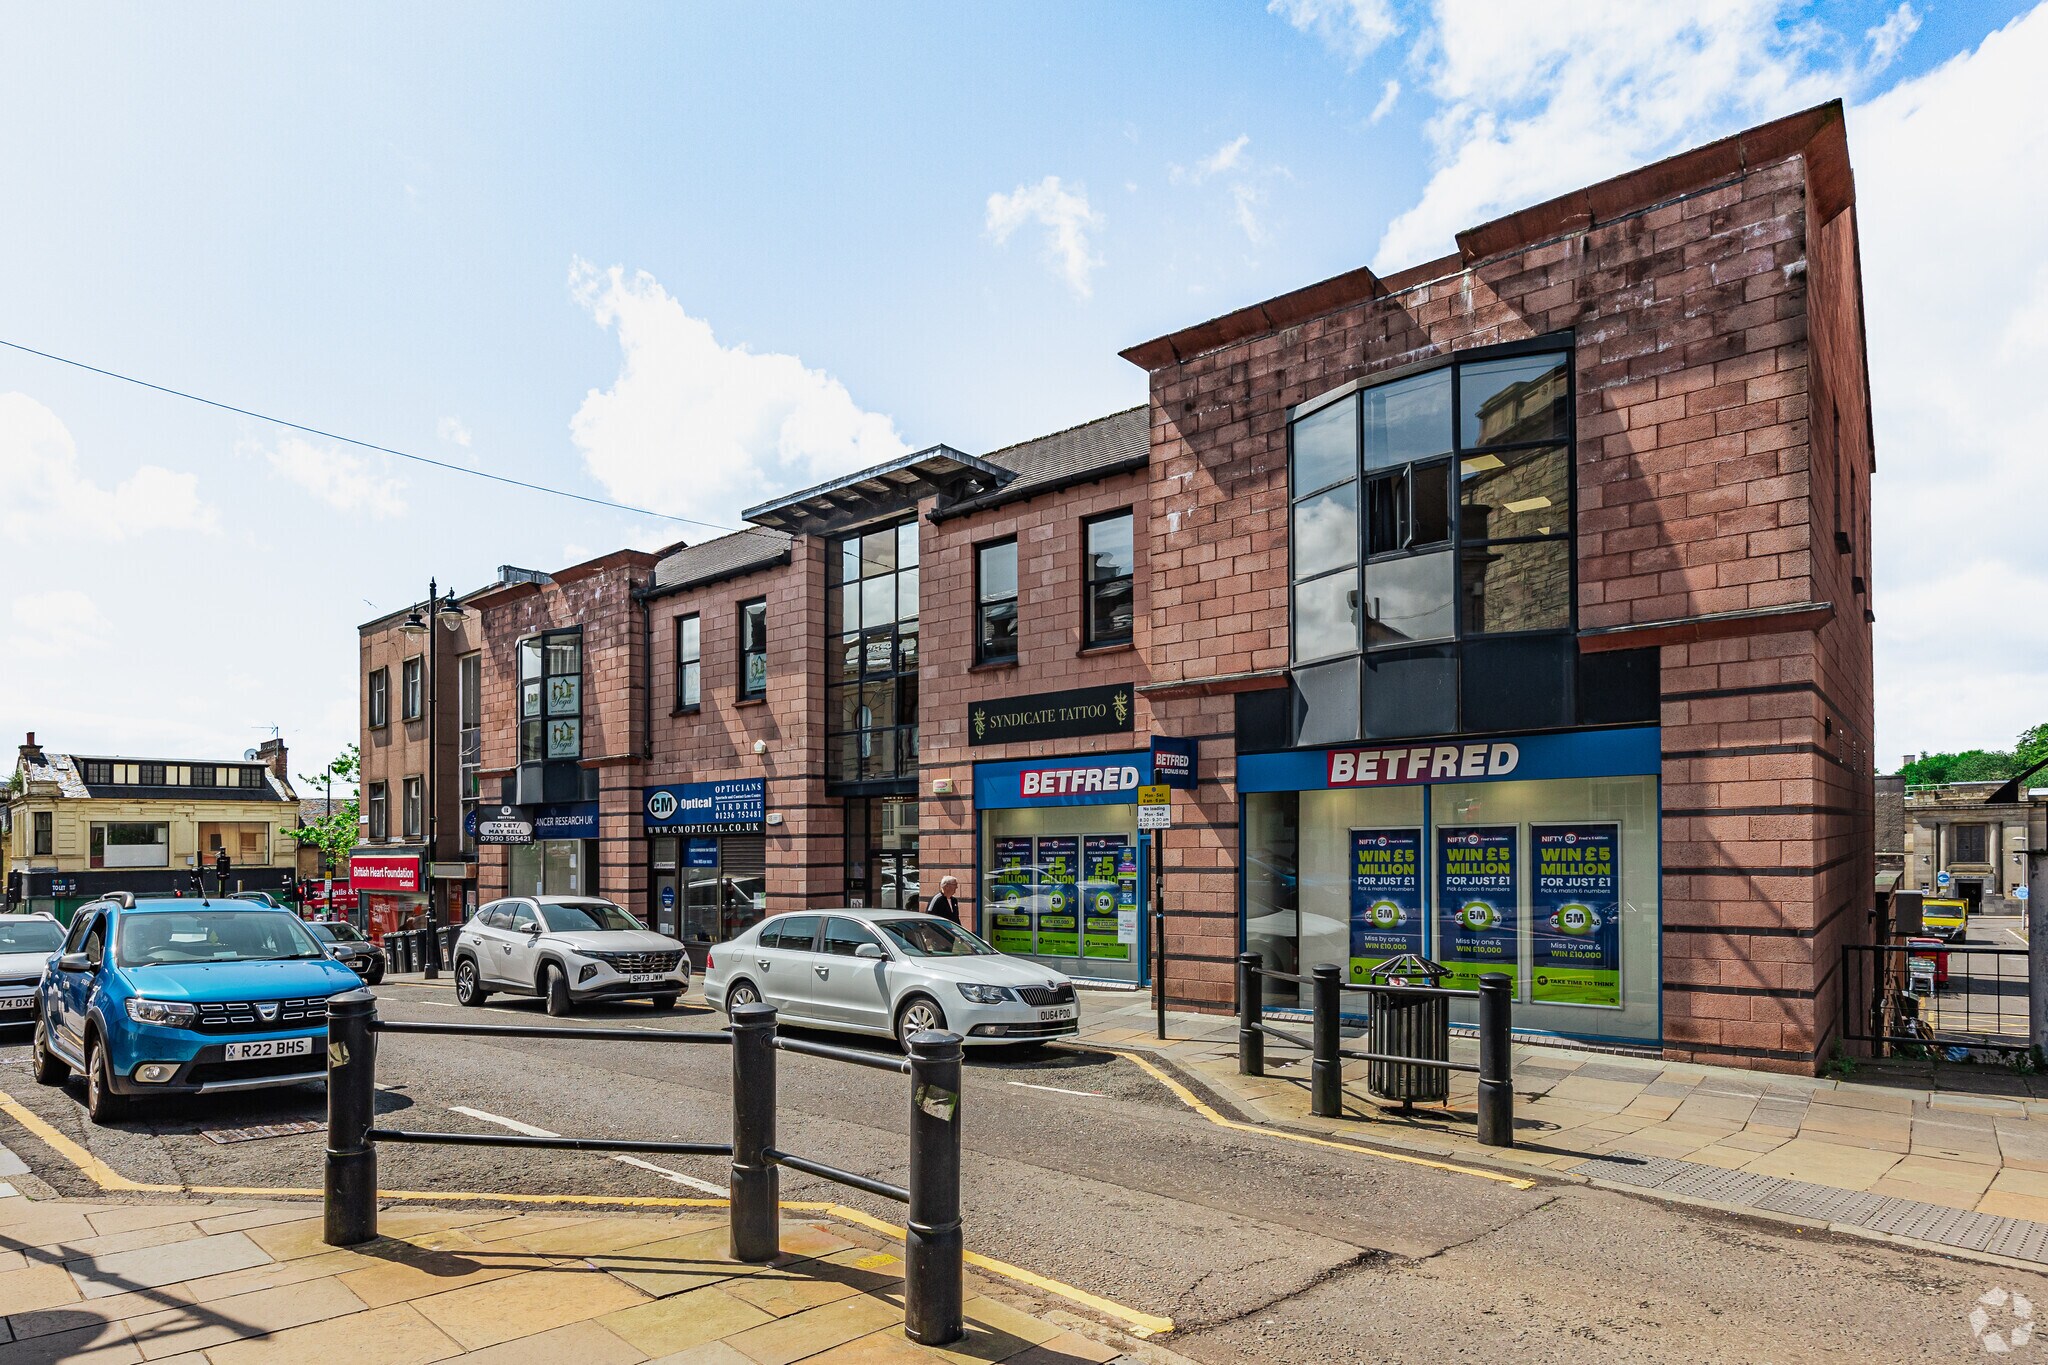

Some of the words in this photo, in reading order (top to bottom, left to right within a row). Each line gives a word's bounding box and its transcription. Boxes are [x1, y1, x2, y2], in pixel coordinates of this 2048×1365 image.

[990, 709, 1056, 729] SYNDICATE
[1058, 703, 1107, 721] TATTOO
[1156, 753, 1189, 767] BETFRED
[1331, 743, 1520, 783] BETFRED
[1023, 766, 1139, 795] BETFRED
[714, 782, 762, 794] OPTICIANS
[651, 797, 673, 813] CM
[680, 797, 712, 811] Optical
[715, 801, 762, 811] AIRDRIE
[715, 811, 735, 819] 01236
[737, 810, 761, 819] 752481
[534, 817, 554, 826] ANCER
[555, 816, 584, 826] RESEARCH
[584, 815, 594, 825] UK
[647, 823, 759, 834] WWW.CMOPTICAL.CO.UK
[1358, 850, 1390, 862] WIN
[1446, 848, 1483, 861] WIN
[1541, 848, 1581, 861] WIN
[353, 866, 369, 877] British
[370, 867, 384, 878] Heart
[384, 867, 414, 878] Foundation
[1358, 863, 1414, 875] MILLION
[1446, 863, 1510, 874] MILLION
[1541, 863, 1611, 875] MILLION
[998, 875, 1030, 884] MILLION
[1041, 875, 1075, 884] MILLION
[1358, 877, 1376, 885] FOR
[1377, 877, 1402, 885] JUST
[1404, 877, 1414, 885] £1
[1446, 877, 1467, 885] FOR
[1469, 877, 1496, 885] JUST
[1498, 876, 1510, 885] £1
[1541, 877, 1564, 886] FOR
[1566, 877, 1595, 886] JUST
[1598, 877, 1611, 887] £1
[1377, 909, 1393, 918] 5M
[1469, 910, 1486, 920] 5M
[1565, 913, 1584, 923] 5M
[1471, 938, 1479, 946] by
[1567, 943, 1577, 951] by
[1473, 946, 1502, 954] £10,000
[1569, 951, 1602, 959] £10,000
[632, 974, 650, 982] SH73
[0, 1000, 12, 1008] 74
[1040, 1010, 1058, 1020] OU64
[241, 1043, 272, 1058] R22
[276, 1040, 305, 1055] BHS
